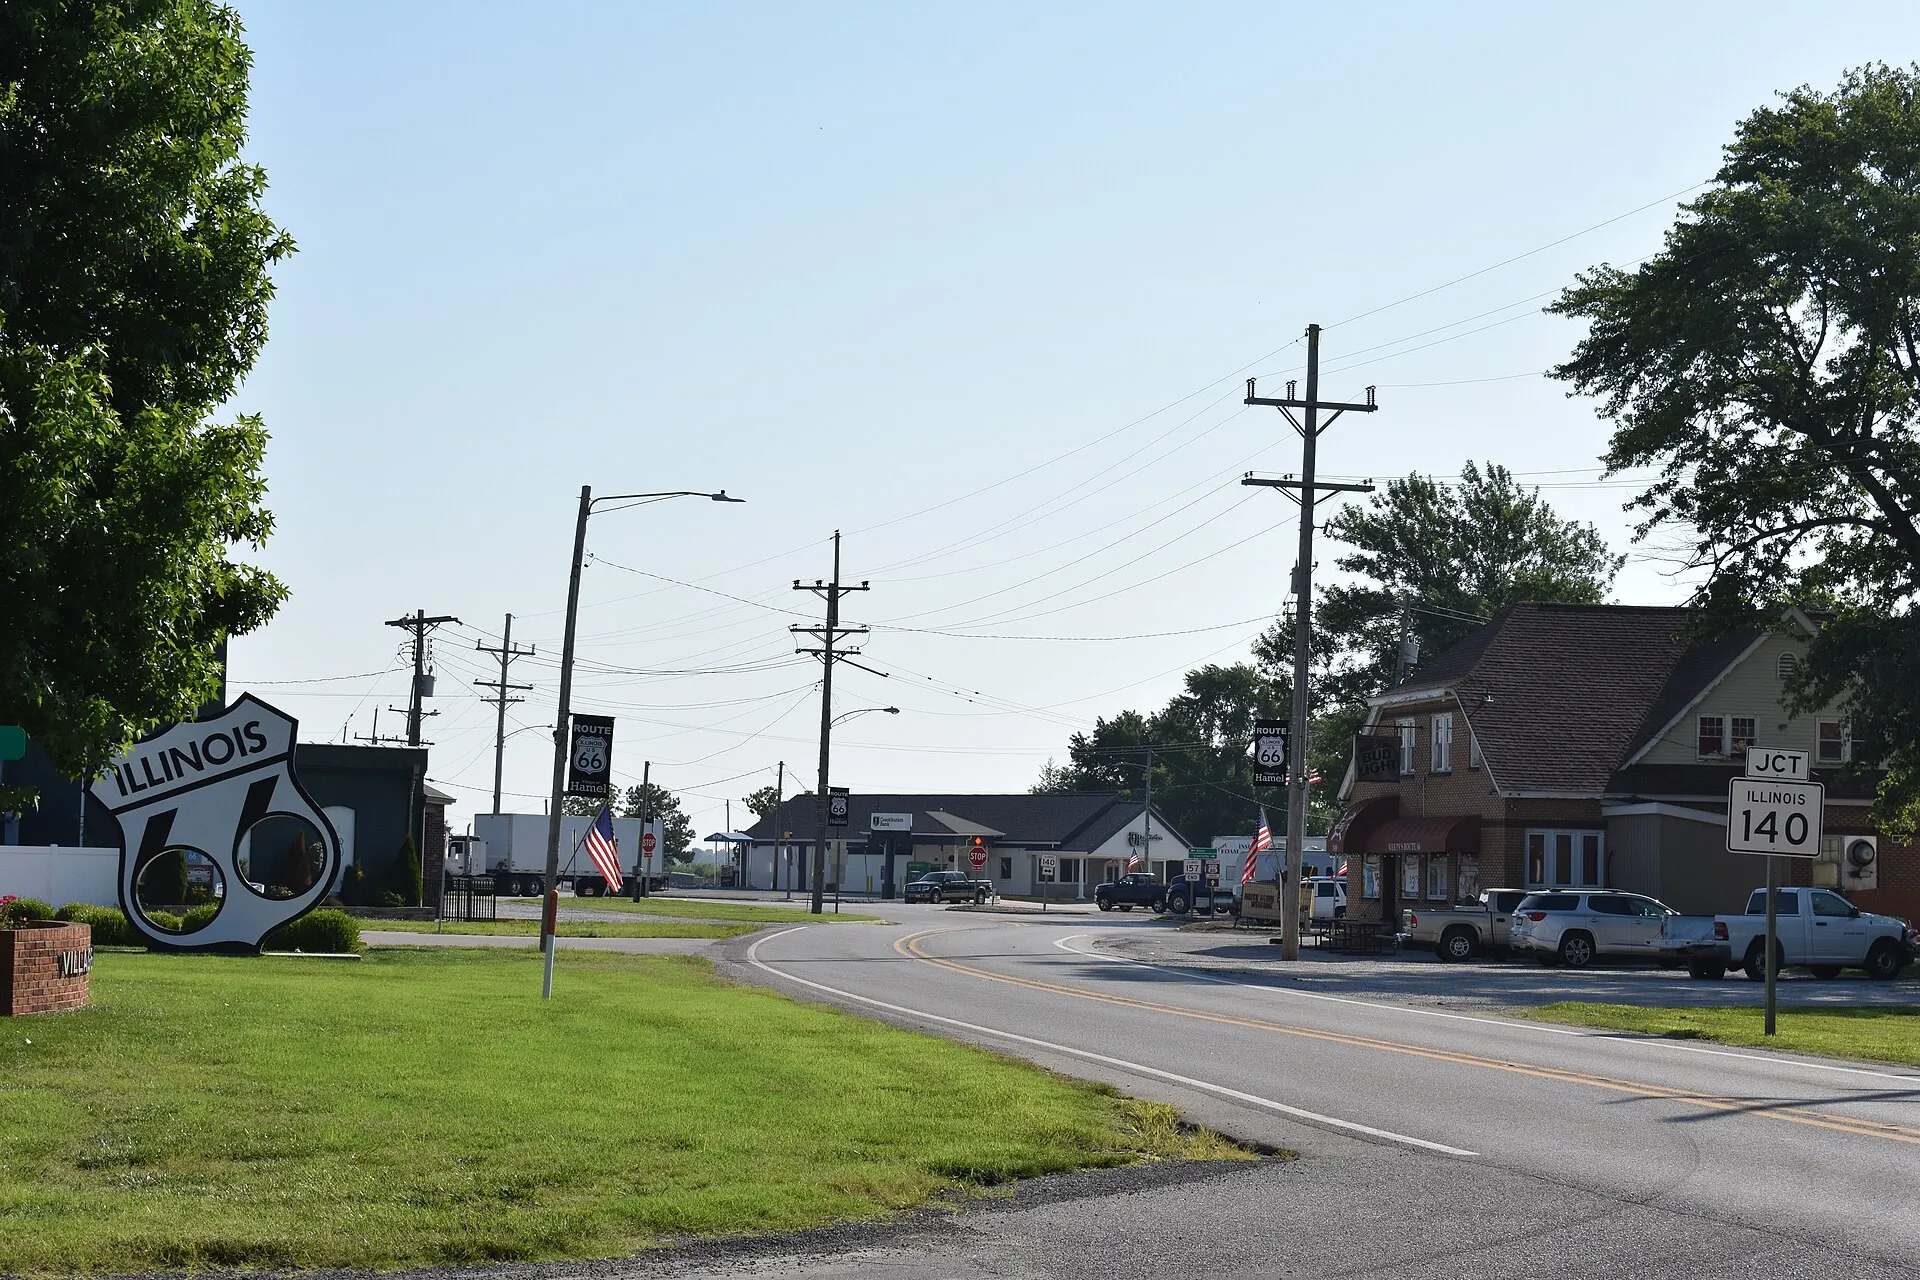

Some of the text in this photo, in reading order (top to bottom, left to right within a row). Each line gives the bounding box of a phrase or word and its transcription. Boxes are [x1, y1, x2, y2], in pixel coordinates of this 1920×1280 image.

[573, 724, 612, 735] ROUTE
[1256, 727, 1287, 735] ROUTE
[114, 720, 268, 797] ILLINOIS
[577, 751, 602, 769] 66
[1260, 749, 1281, 763] 66
[1362, 750, 1392, 763] BUD
[1360, 760, 1396, 776] LIGHT
[1755, 753, 1802, 774] JCT
[1255, 773, 1285, 783] Hamel
[570, 781, 607, 793] Hamel
[1747, 790, 1806, 805] ILLINOIS
[832, 804, 845, 813] 66
[1742, 809, 1809, 846] 140
[643, 839, 656, 847] STOP
[131, 774, 328, 936] 66
[970, 852, 986, 861] STOP
[1042, 858, 1055, 866] 140
[1186, 864, 1199, 872] 157
